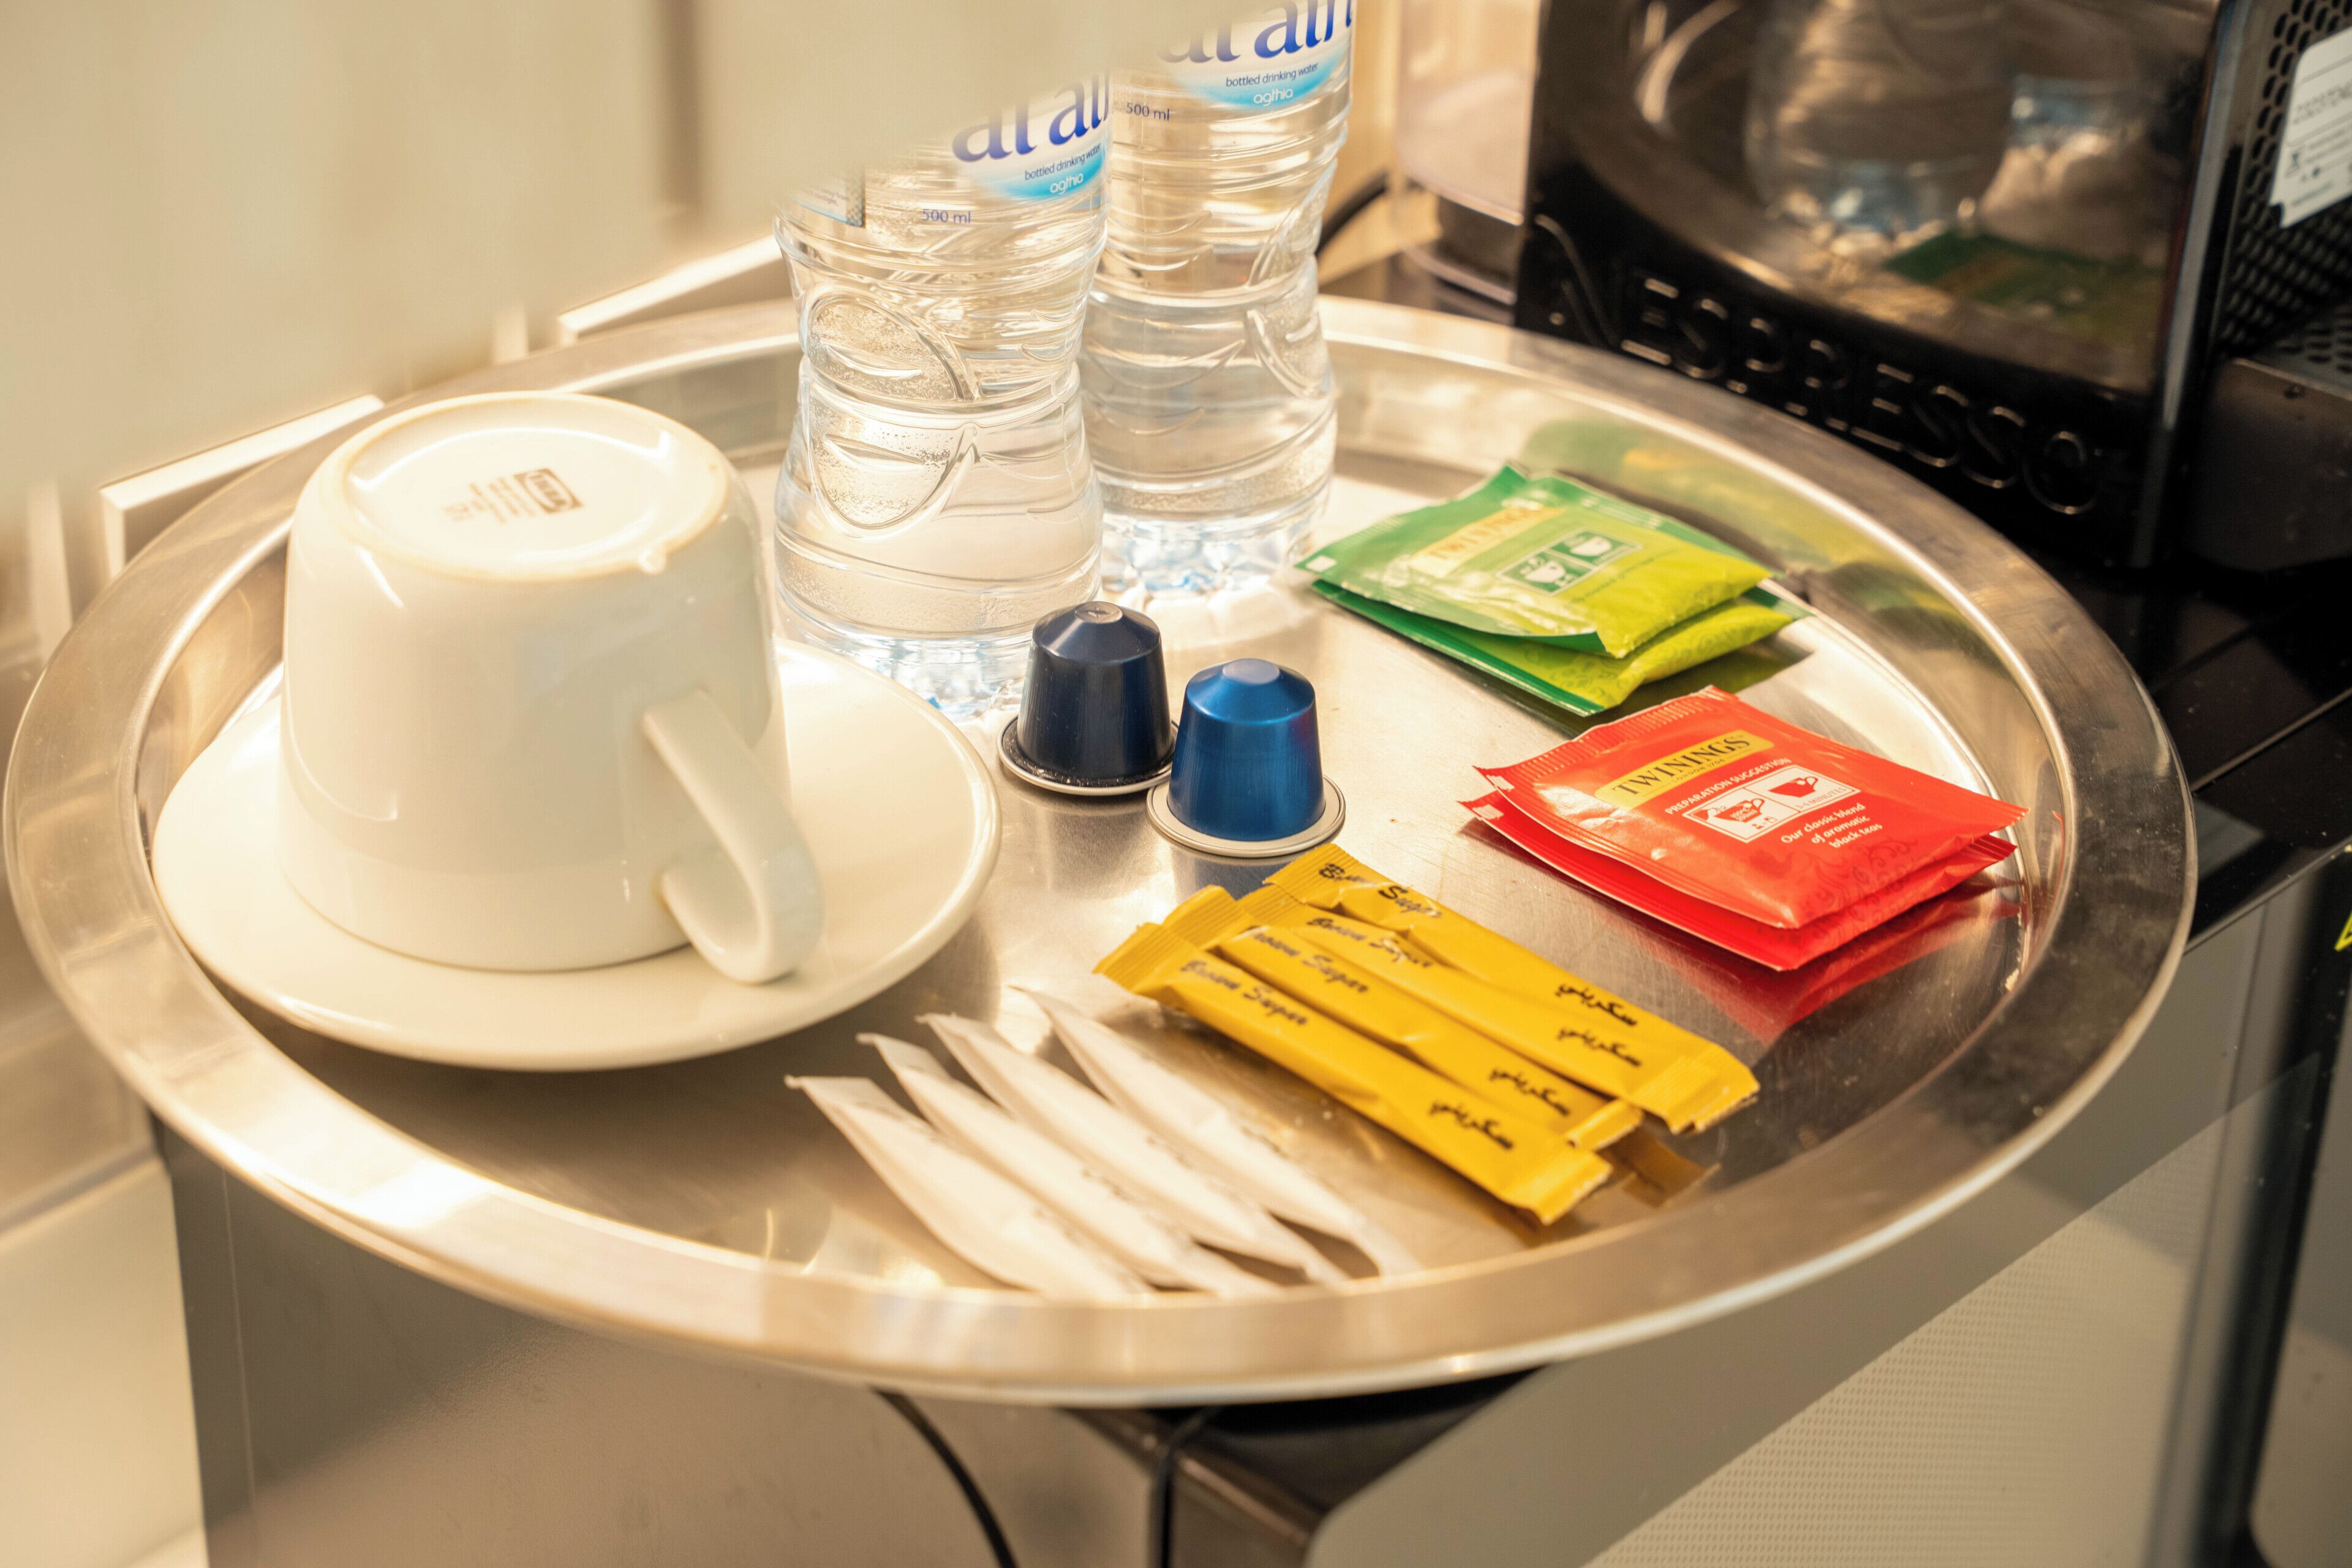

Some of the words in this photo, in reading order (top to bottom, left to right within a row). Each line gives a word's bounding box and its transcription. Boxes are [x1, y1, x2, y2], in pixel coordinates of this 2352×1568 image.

[1226, 74, 1261, 87] bottled
[1262, 69, 1297, 85] drinking
[1297, 62, 1318, 77] water
[1253, 87, 1294, 107] agthia
[1126, 102, 1150, 118] 500
[1153, 108, 1170, 121] ml
[1024, 163, 1055, 181] bottled
[1056, 153, 1086, 172] drinking
[1086, 143, 1101, 160] water
[921, 208, 949, 223] 500
[953, 211, 971, 224] ml
[1534, 211, 2102, 517] NESPRESSO
[1613, 736, 1751, 795] TWININGS
[1665, 778, 1733, 815] PREPARATION
[1729, 758, 1792, 785] SUGGESTION
[1807, 786, 1847, 805] MINUTES
[1781, 829, 1804, 844] Our
[1804, 815, 1835, 834] classic
[1834, 802, 1866, 820] blend
[1811, 832, 1826, 845] of
[1823, 815, 1871, 838] aromatic
[1828, 831, 1861, 849] black
[1858, 823, 1883, 837] teas
